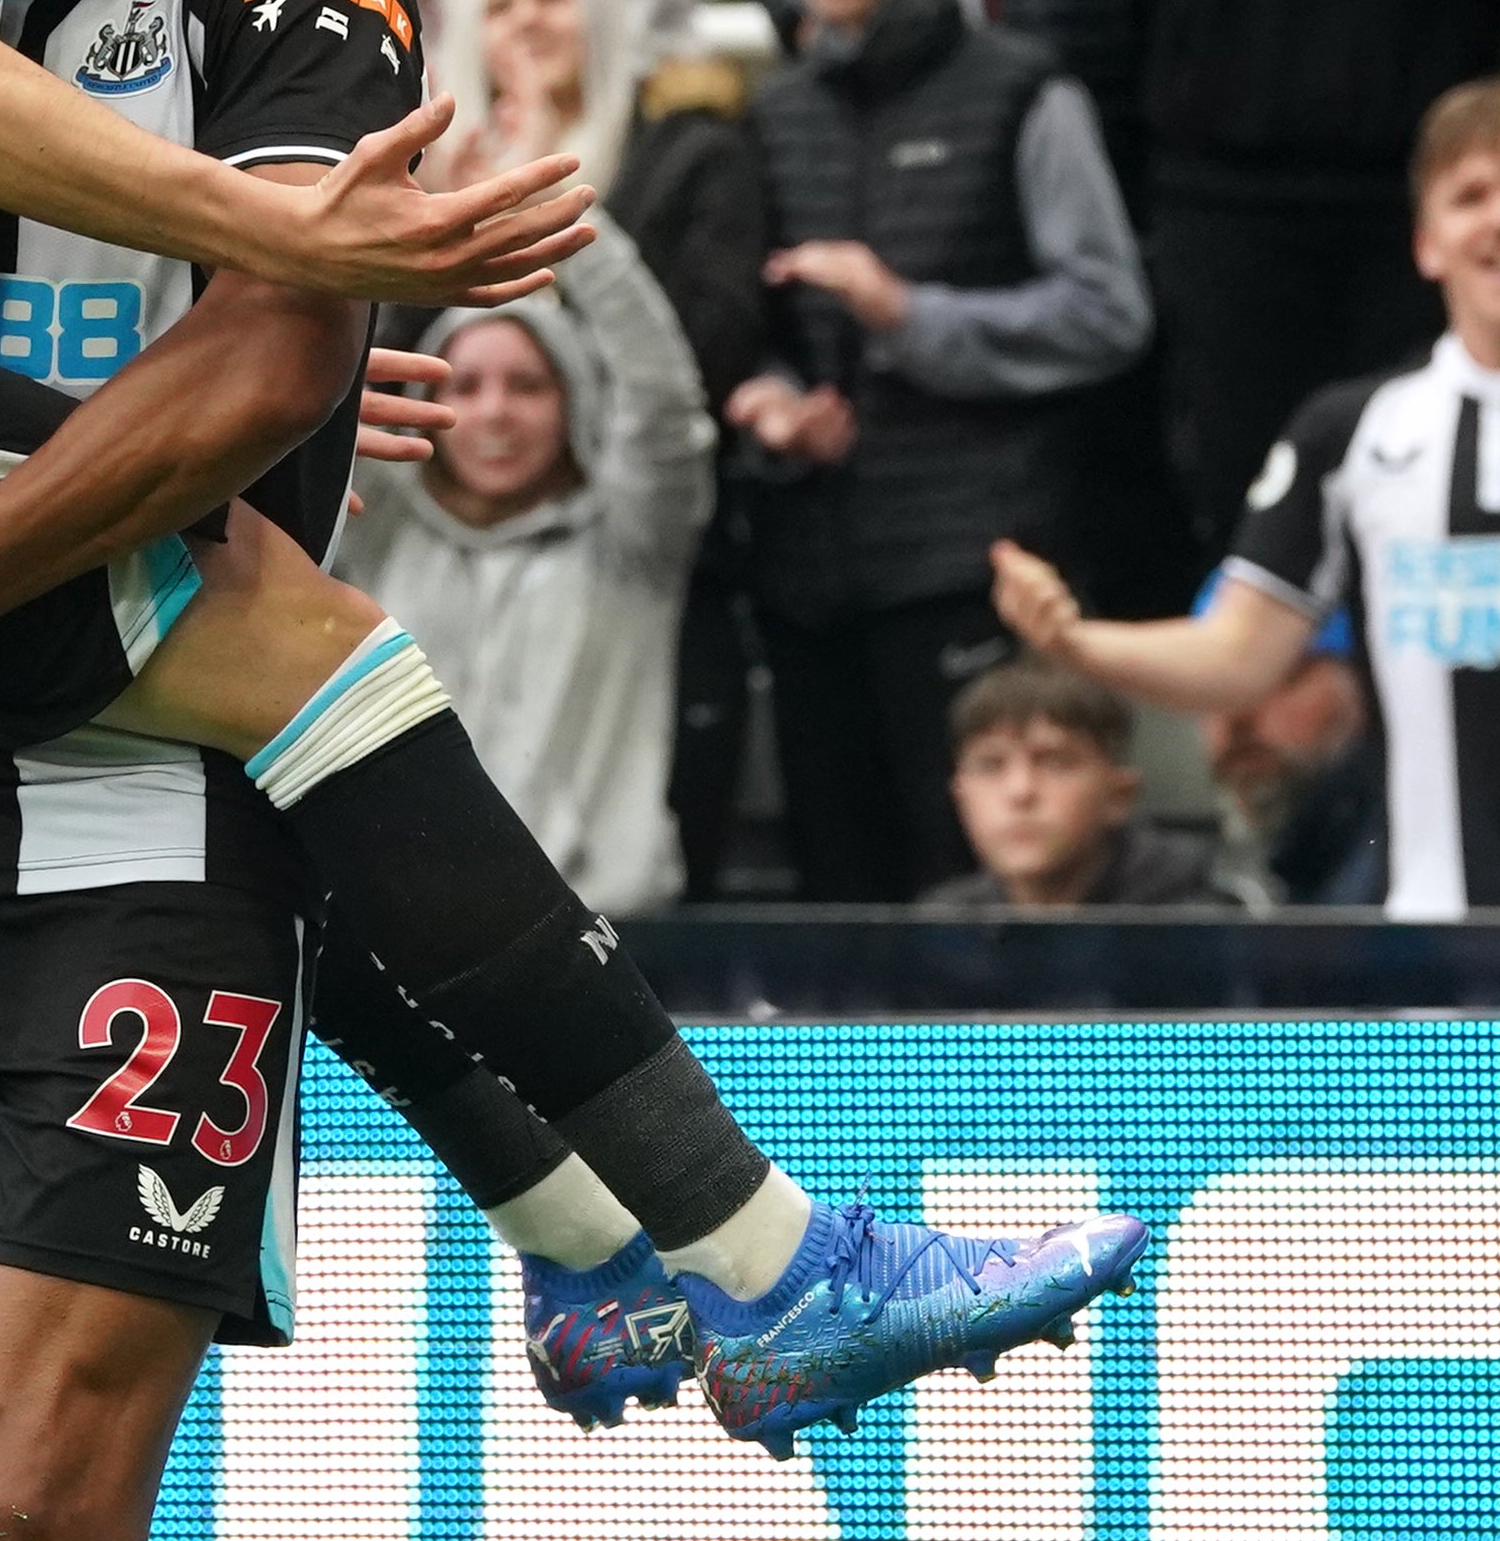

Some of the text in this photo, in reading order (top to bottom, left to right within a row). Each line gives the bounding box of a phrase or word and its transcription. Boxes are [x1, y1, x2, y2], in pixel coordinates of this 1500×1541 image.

[65, 978, 282, 1167] 23
[129, 1226, 211, 1259] CASTORE
[757, 1291, 815, 1349] FRANCESCO
